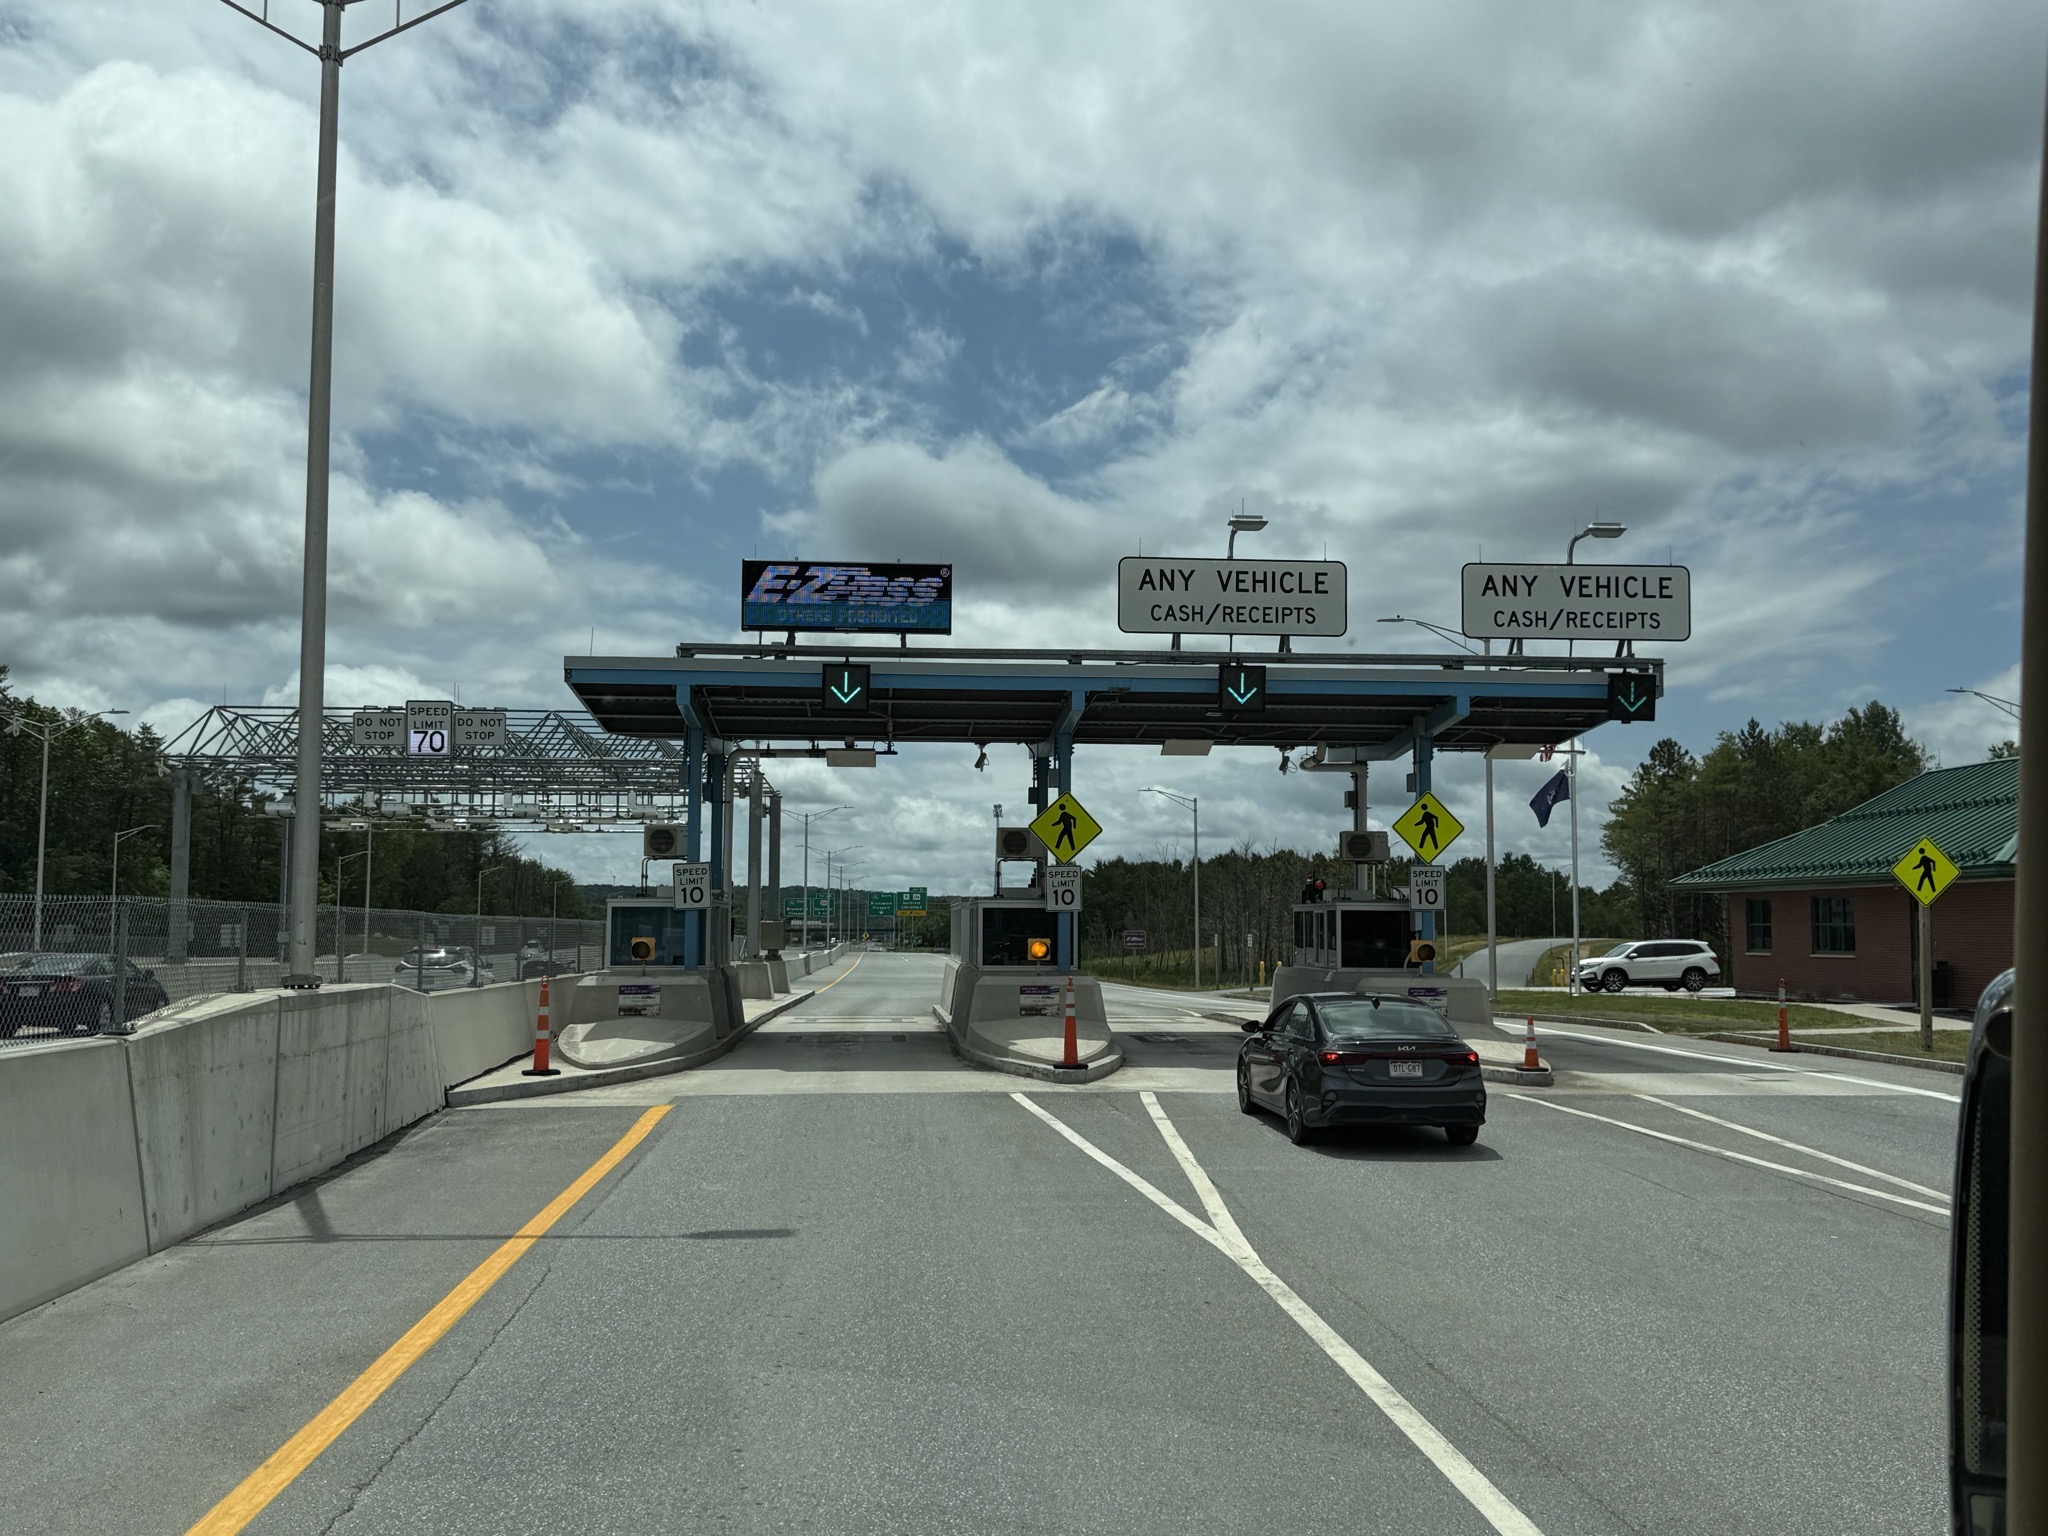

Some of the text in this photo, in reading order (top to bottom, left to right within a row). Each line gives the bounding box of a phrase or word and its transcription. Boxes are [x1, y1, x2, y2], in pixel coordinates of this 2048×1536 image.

[1138, 569, 1329, 595] ANY VEHICLE
[1481, 574, 1674, 599] ANY VEHICLE
[1150, 603, 1316, 626] CASH/RECEIPTS
[1493, 608, 1661, 631] CASH/RECEIPTS
[410, 707, 449, 716] SPEED
[356, 717, 402, 727] DO NOT
[413, 720, 445, 730] LIMIT
[457, 717, 503, 728] DO NOT
[364, 730, 395, 741] STOP
[465, 731, 495, 741] STOP
[412, 731, 445, 753] 70
[676, 868, 708, 877] SPEED
[1048, 870, 1079, 879] SPEED
[1412, 870, 1443, 878] SPEED
[679, 877, 705, 886] LIMIT
[1051, 879, 1075, 888] LIMIT
[1415, 879, 1439, 887] LIMIT
[680, 886, 704, 904] 10
[1052, 888, 1075, 906] 10
[1416, 888, 1439, 905] 10
